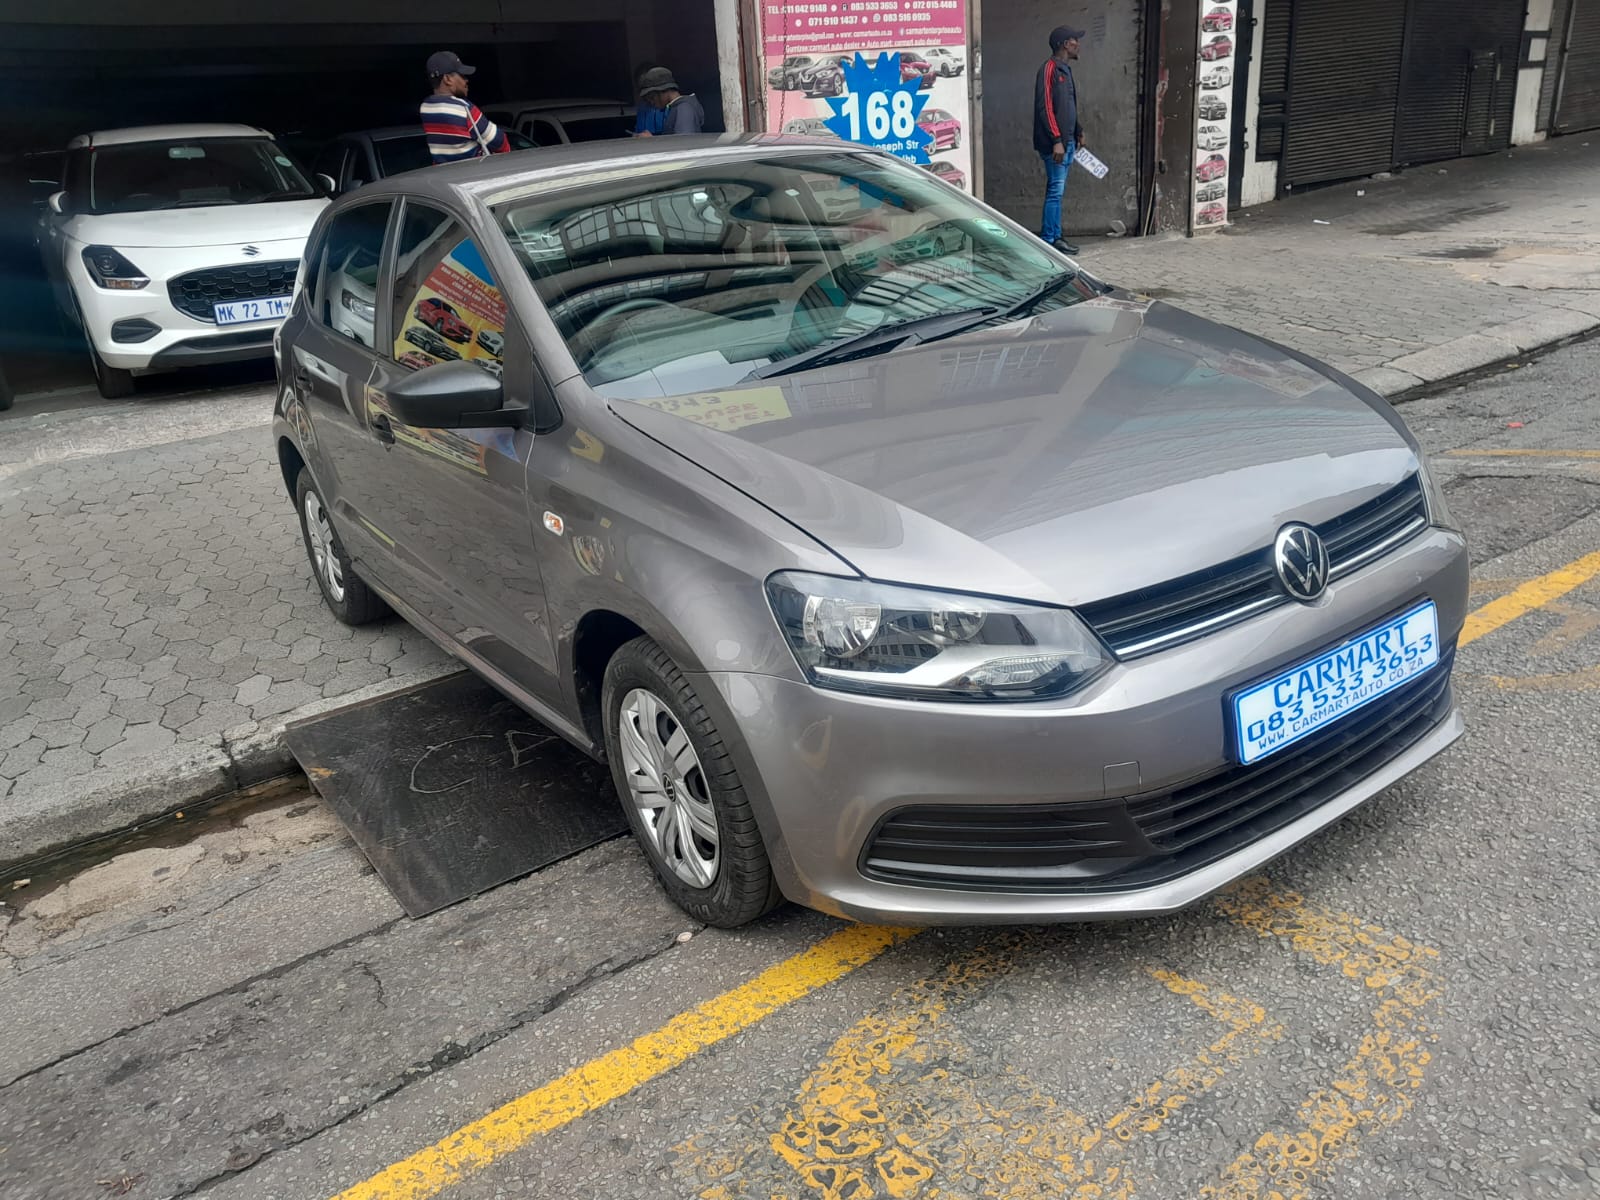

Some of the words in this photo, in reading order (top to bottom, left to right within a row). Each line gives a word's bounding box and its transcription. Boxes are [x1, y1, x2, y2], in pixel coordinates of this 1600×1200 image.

[913, 0, 925, 9] 072
[926, 0, 939, 9] 015
[808, 17, 822, 26] 071
[823, 16, 839, 25] 910
[840, 15, 858, 25] 1437
[842, 90, 915, 141] 168
[906, 140, 920, 150] Str
[1076, 149, 1093, 164] 307
[217, 305, 236, 321] MK
[242, 303, 260, 318] 72
[266, 300, 284, 315] TM
[1273, 619, 1408, 709] CARMART
[1246, 699, 1304, 743] 083
[1312, 669, 1364, 710] 533
[1372, 633, 1433, 679] 3653
